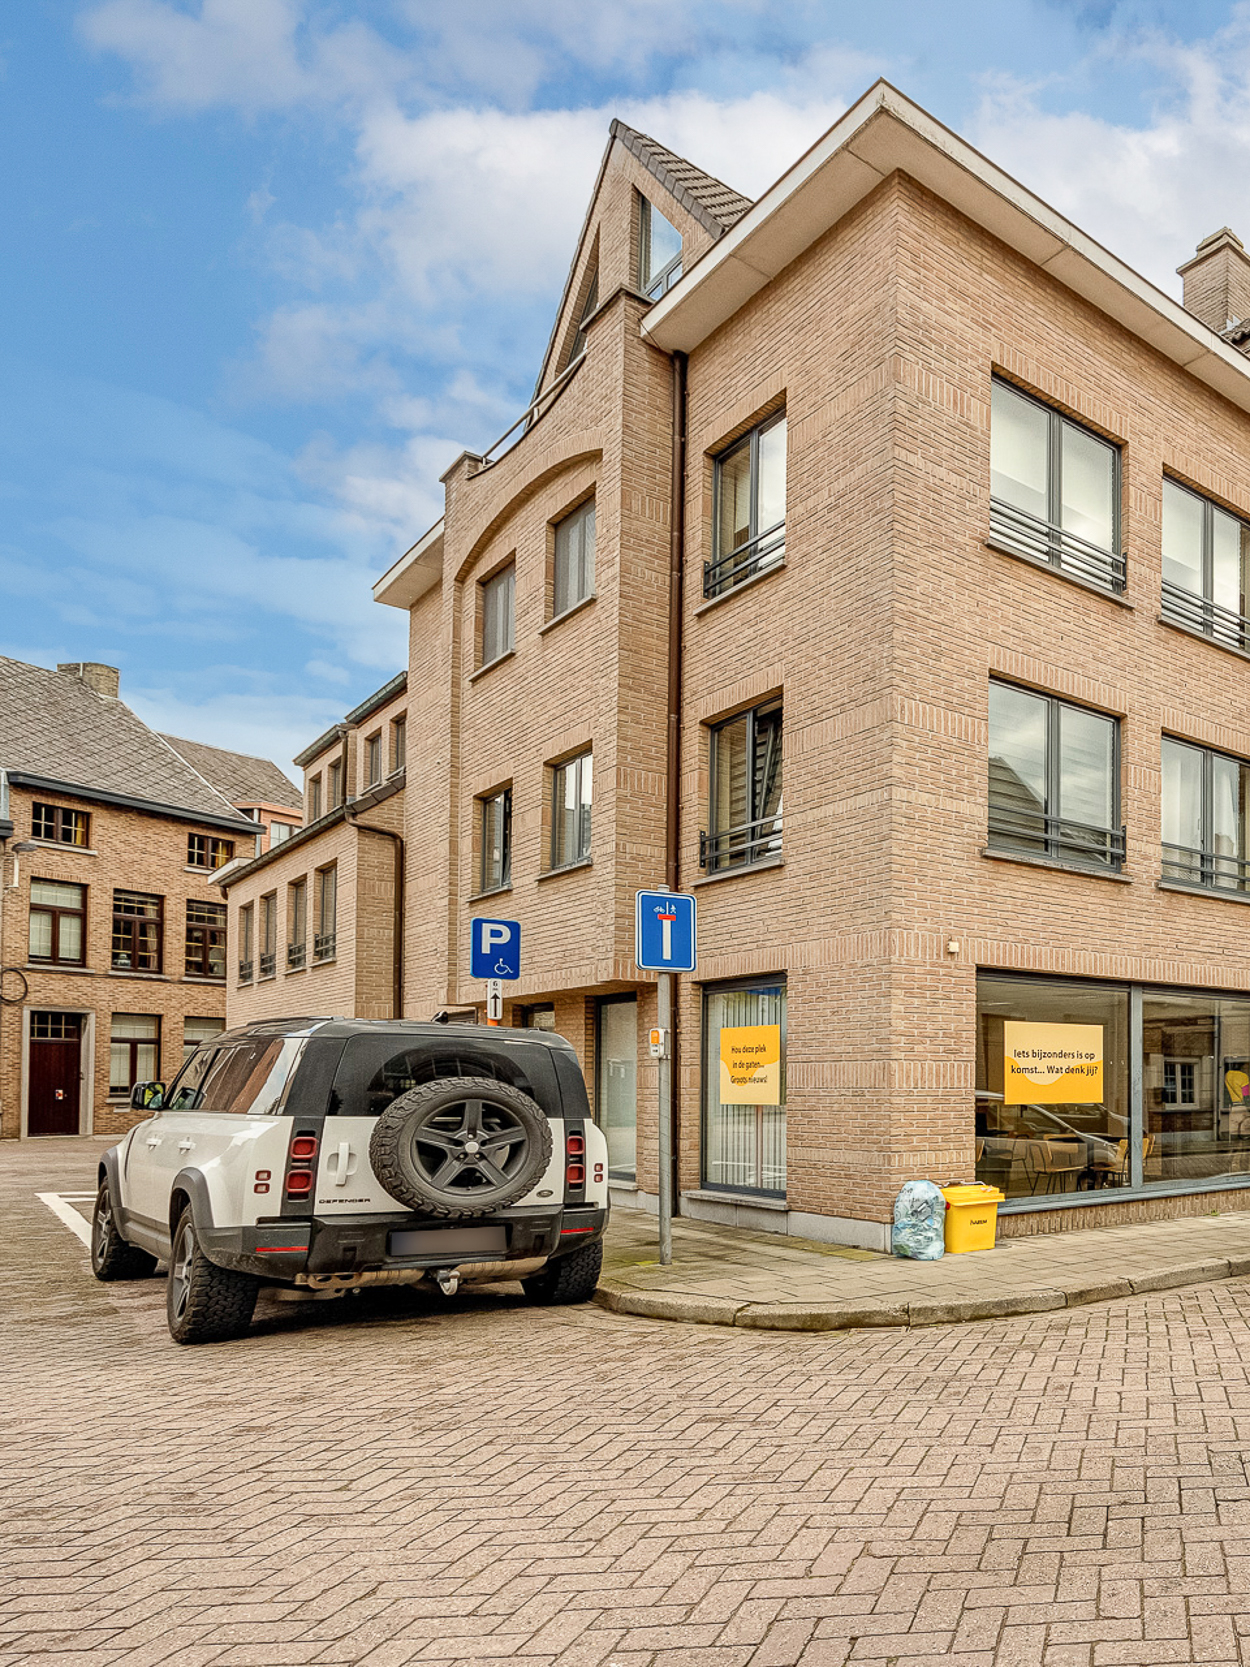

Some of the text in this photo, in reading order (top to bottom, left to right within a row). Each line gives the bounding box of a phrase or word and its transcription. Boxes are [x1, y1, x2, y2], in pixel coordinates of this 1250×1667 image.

[481, 923, 511, 954] P
[731, 1044, 767, 1055] Hou deze plek
[1013, 1049, 1096, 1061] Iets bijzonders is op
[732, 1060, 737, 1068] in
[738, 1060, 744, 1068] de
[1011, 1065, 1099, 1076] komst... Wat denk jij?
[731, 1075, 747, 1084] Groots
